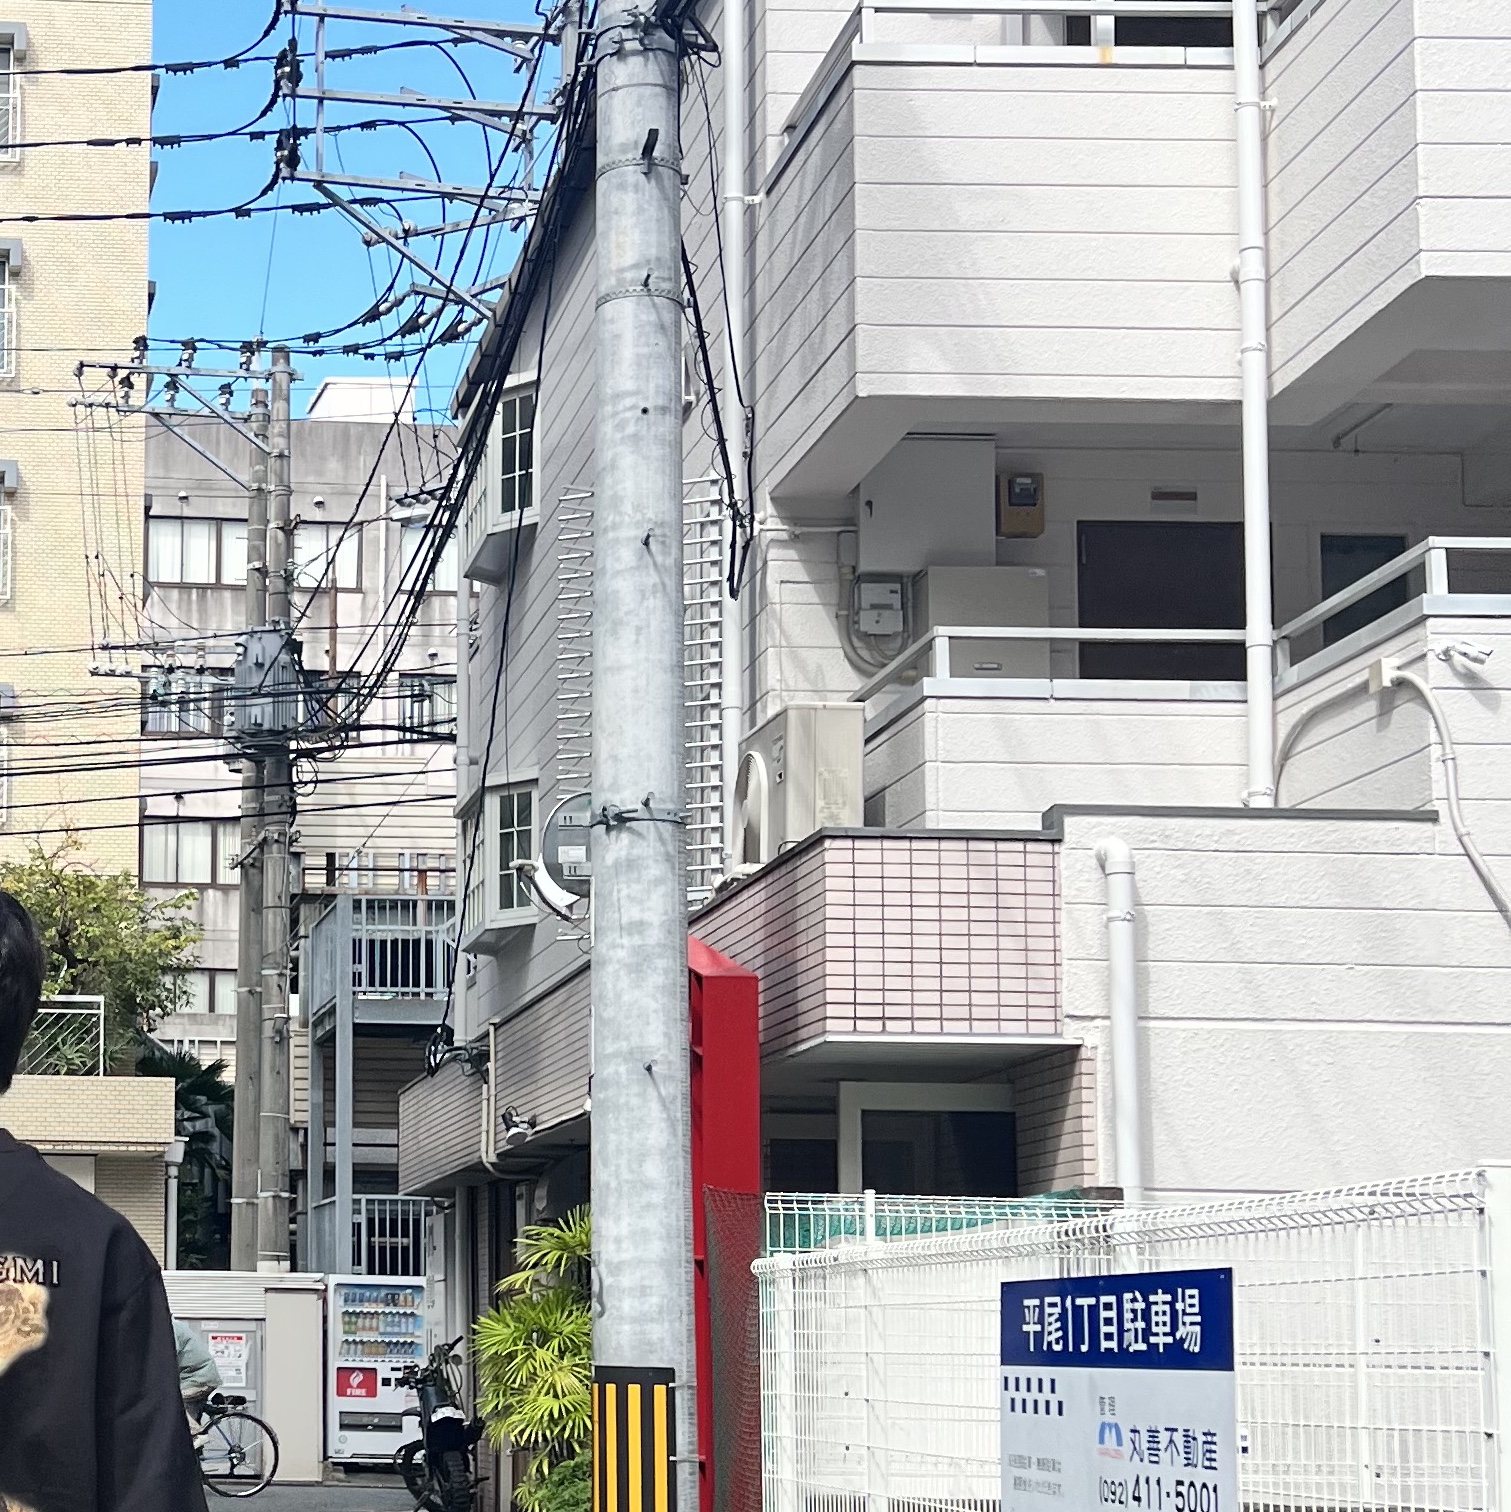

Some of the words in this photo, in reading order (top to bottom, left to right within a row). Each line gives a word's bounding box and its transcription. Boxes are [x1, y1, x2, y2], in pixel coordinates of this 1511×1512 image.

[1022, 1287, 1202, 1353] 平尾1丁目駐車場
[1129, 1425, 1218, 1471] 丸善不動産
